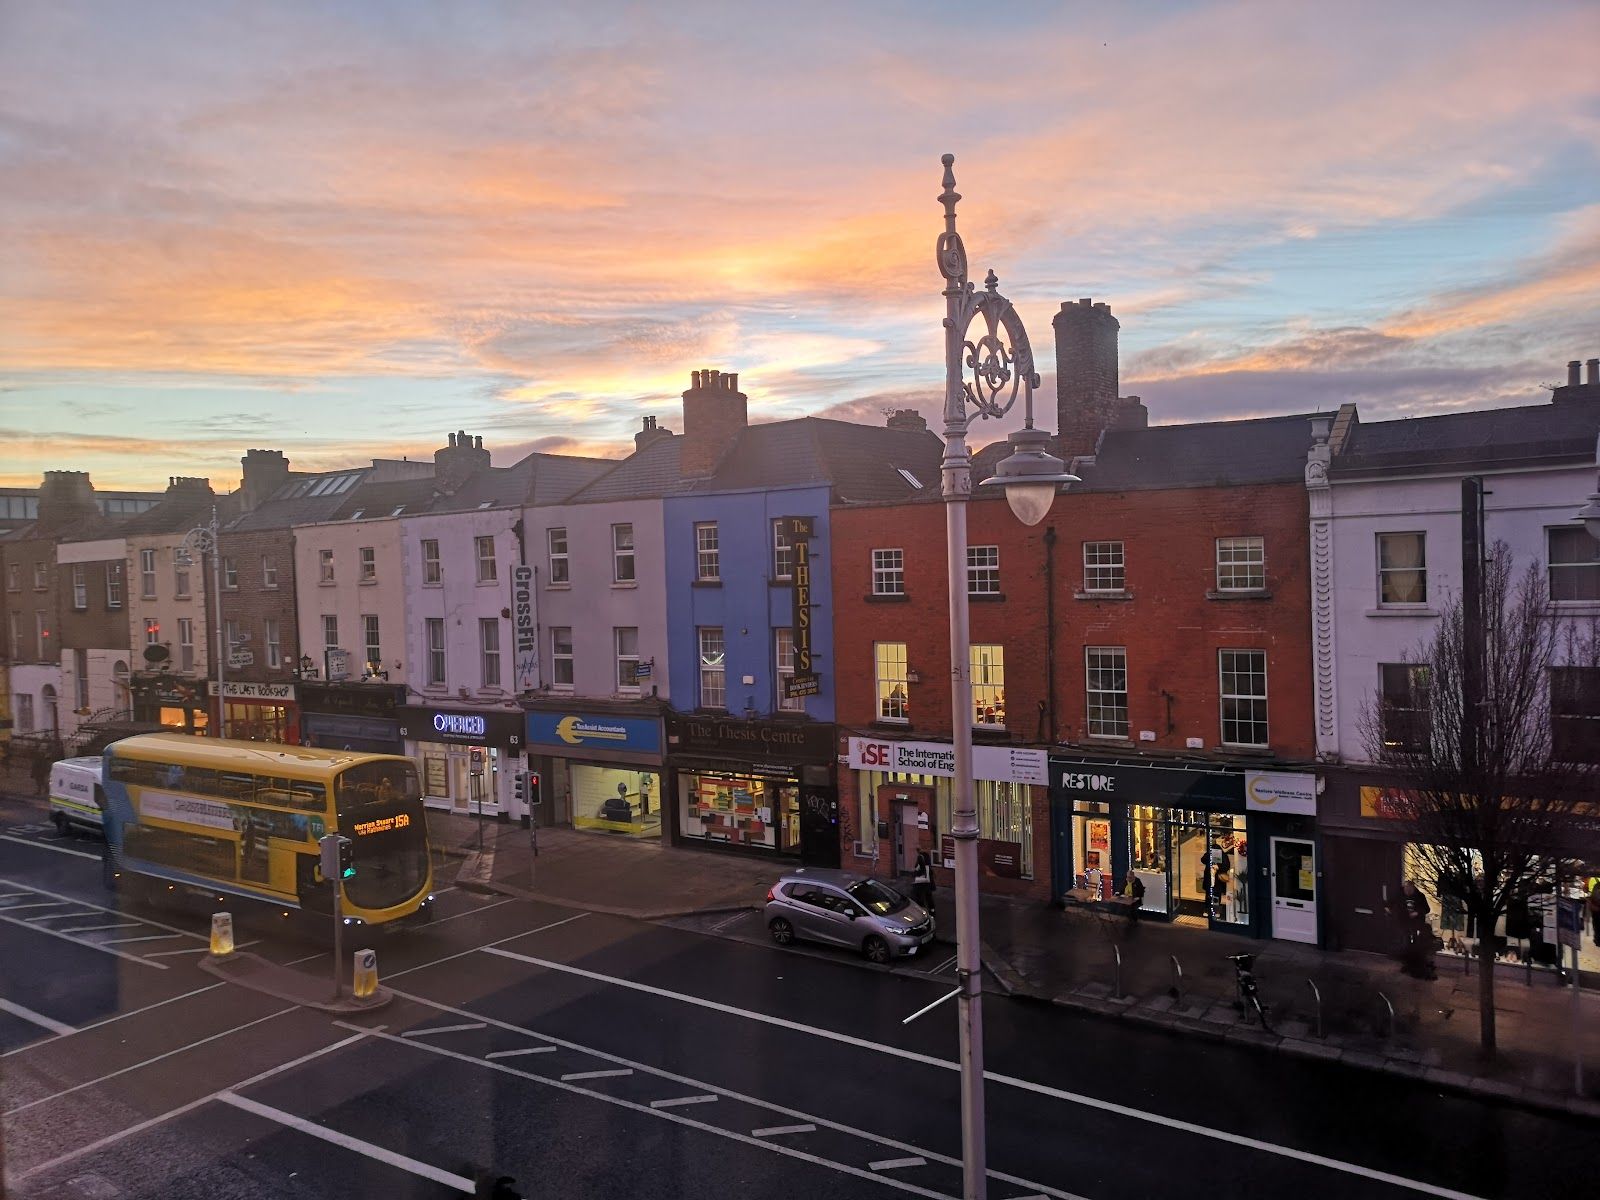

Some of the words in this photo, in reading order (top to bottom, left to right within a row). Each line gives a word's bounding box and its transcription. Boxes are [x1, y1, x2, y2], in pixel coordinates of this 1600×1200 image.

[793, 519, 809, 533] The
[795, 542, 810, 670] THESIS
[239, 685, 255, 695] LAST
[257, 686, 289, 697] BOOKSHOP
[399, 727, 408, 736] 63
[689, 722, 711, 737] The
[719, 725, 757, 740] Thesis
[760, 727, 804, 744] Centre
[509, 735, 519, 744] 63
[898, 746, 915, 758] The
[898, 757, 927, 768] School
[927, 759, 937, 769] of
[938, 760, 955, 772] Eng
[1062, 772, 1115, 792] RESTORE
[394, 814, 409, 828] 15A
